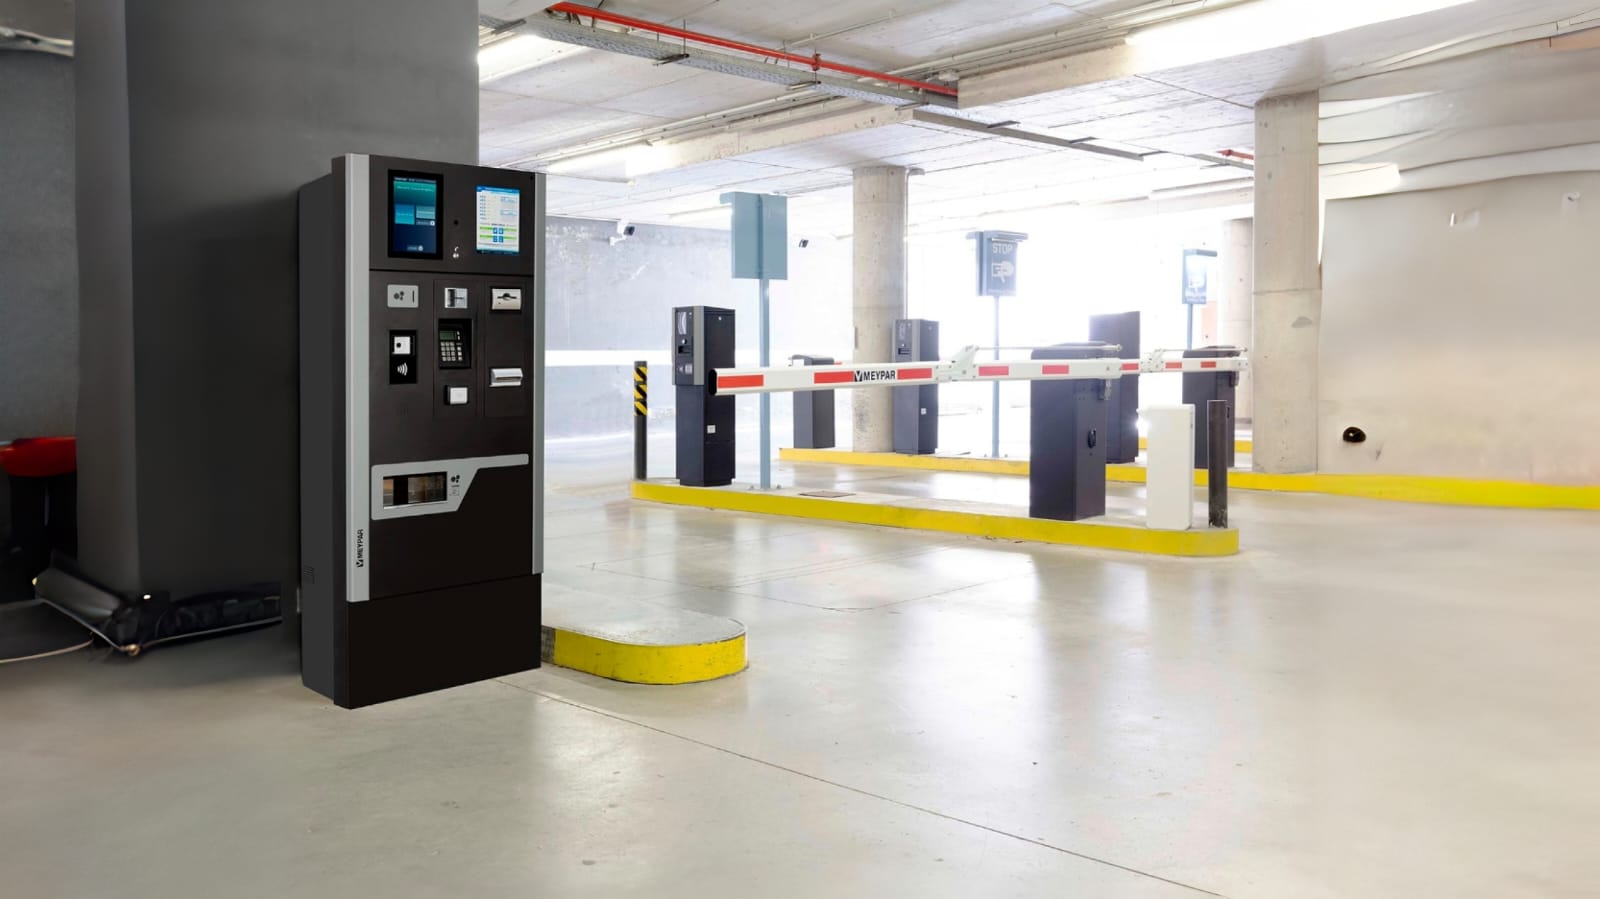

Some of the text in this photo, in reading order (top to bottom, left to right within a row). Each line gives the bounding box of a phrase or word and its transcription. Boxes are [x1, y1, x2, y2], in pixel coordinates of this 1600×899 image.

[992, 242, 1014, 255] STOP
[863, 370, 896, 381] MEYPAR
[356, 529, 364, 559] MEYPAR
